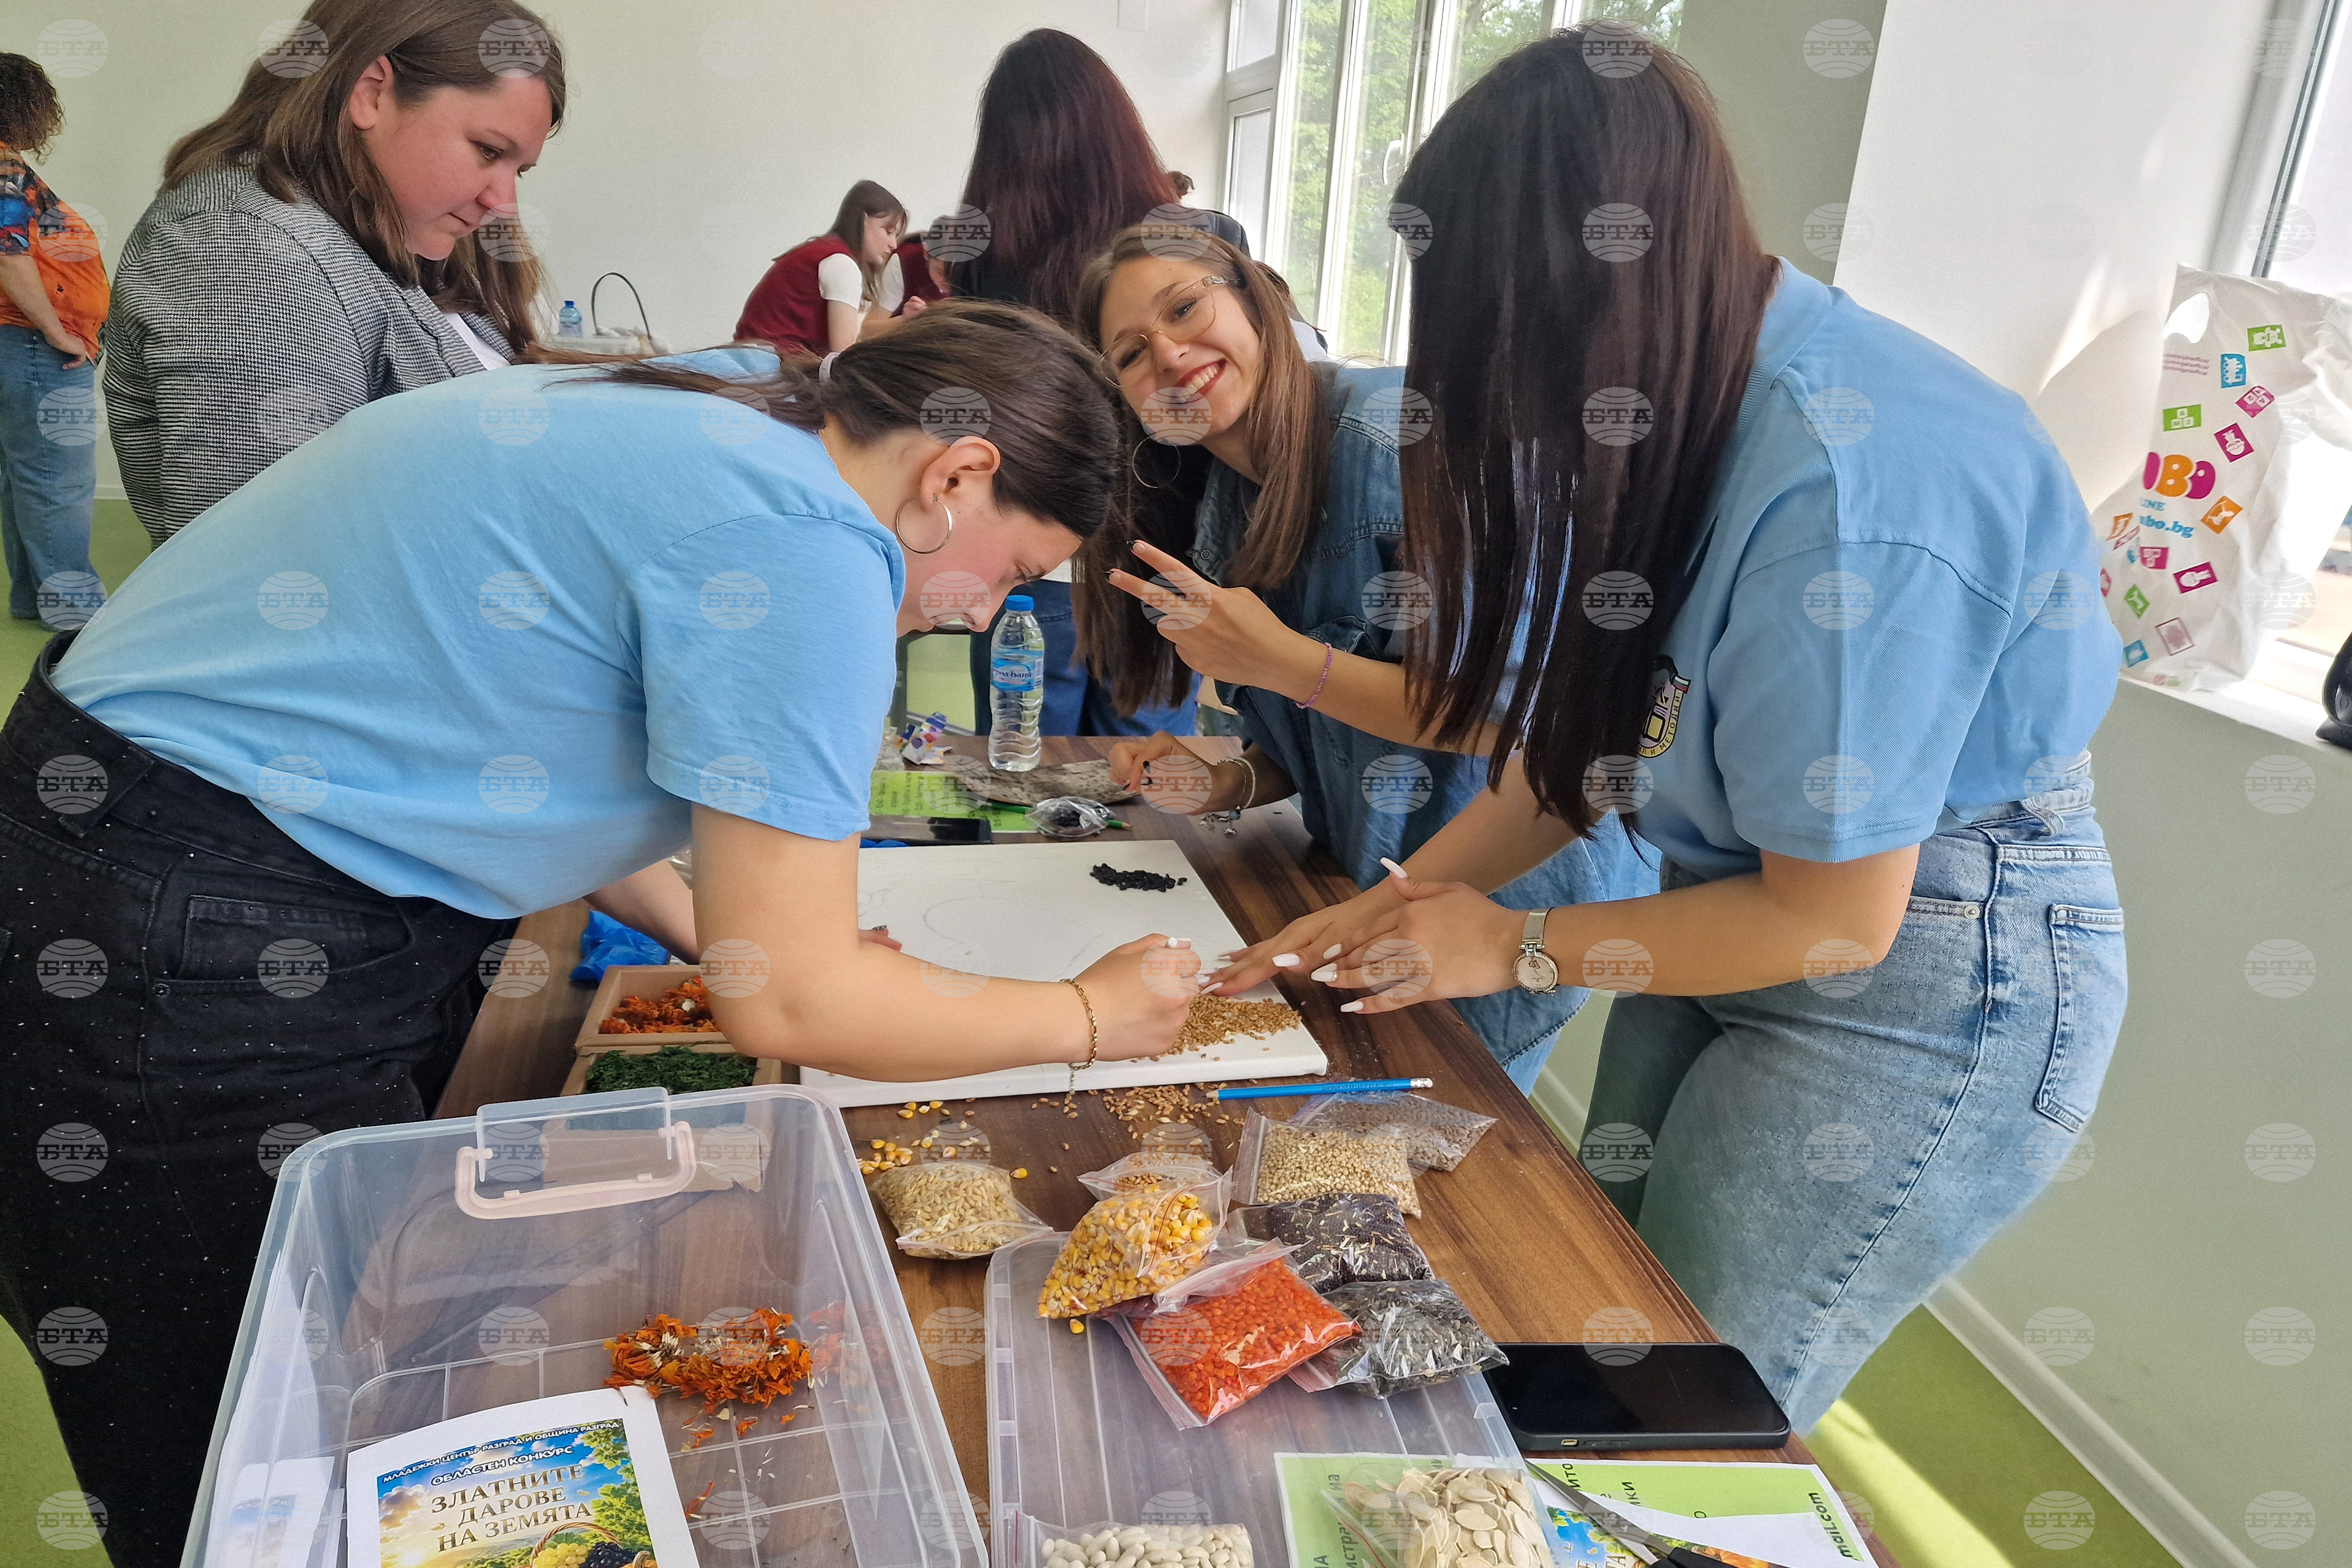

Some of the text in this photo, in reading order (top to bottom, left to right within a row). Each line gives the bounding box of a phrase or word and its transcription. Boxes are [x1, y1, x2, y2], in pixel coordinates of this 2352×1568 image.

[382, 1458, 440, 1483] МЛАДЕЖКИ
[442, 1446, 480, 1463] ЦЕНТЪР
[481, 1437, 523, 1451] РАЗГРАД
[534, 1427, 578, 1440] ОБЩИНА
[580, 1421, 619, 1432] РАЗГРАД
[431, 1445, 574, 1486] ОБЛАСТЕН КОНКУРС
[431, 1464, 584, 1513] ЗЛАТНИТЕ
[1562, 1463, 1582, 1491] ито
[437, 1502, 592, 1552] НА ЗЕМЯТА
[458, 1486, 566, 1528] ДАРОВЕ
[1808, 1492, 1860, 1561] mail.com
